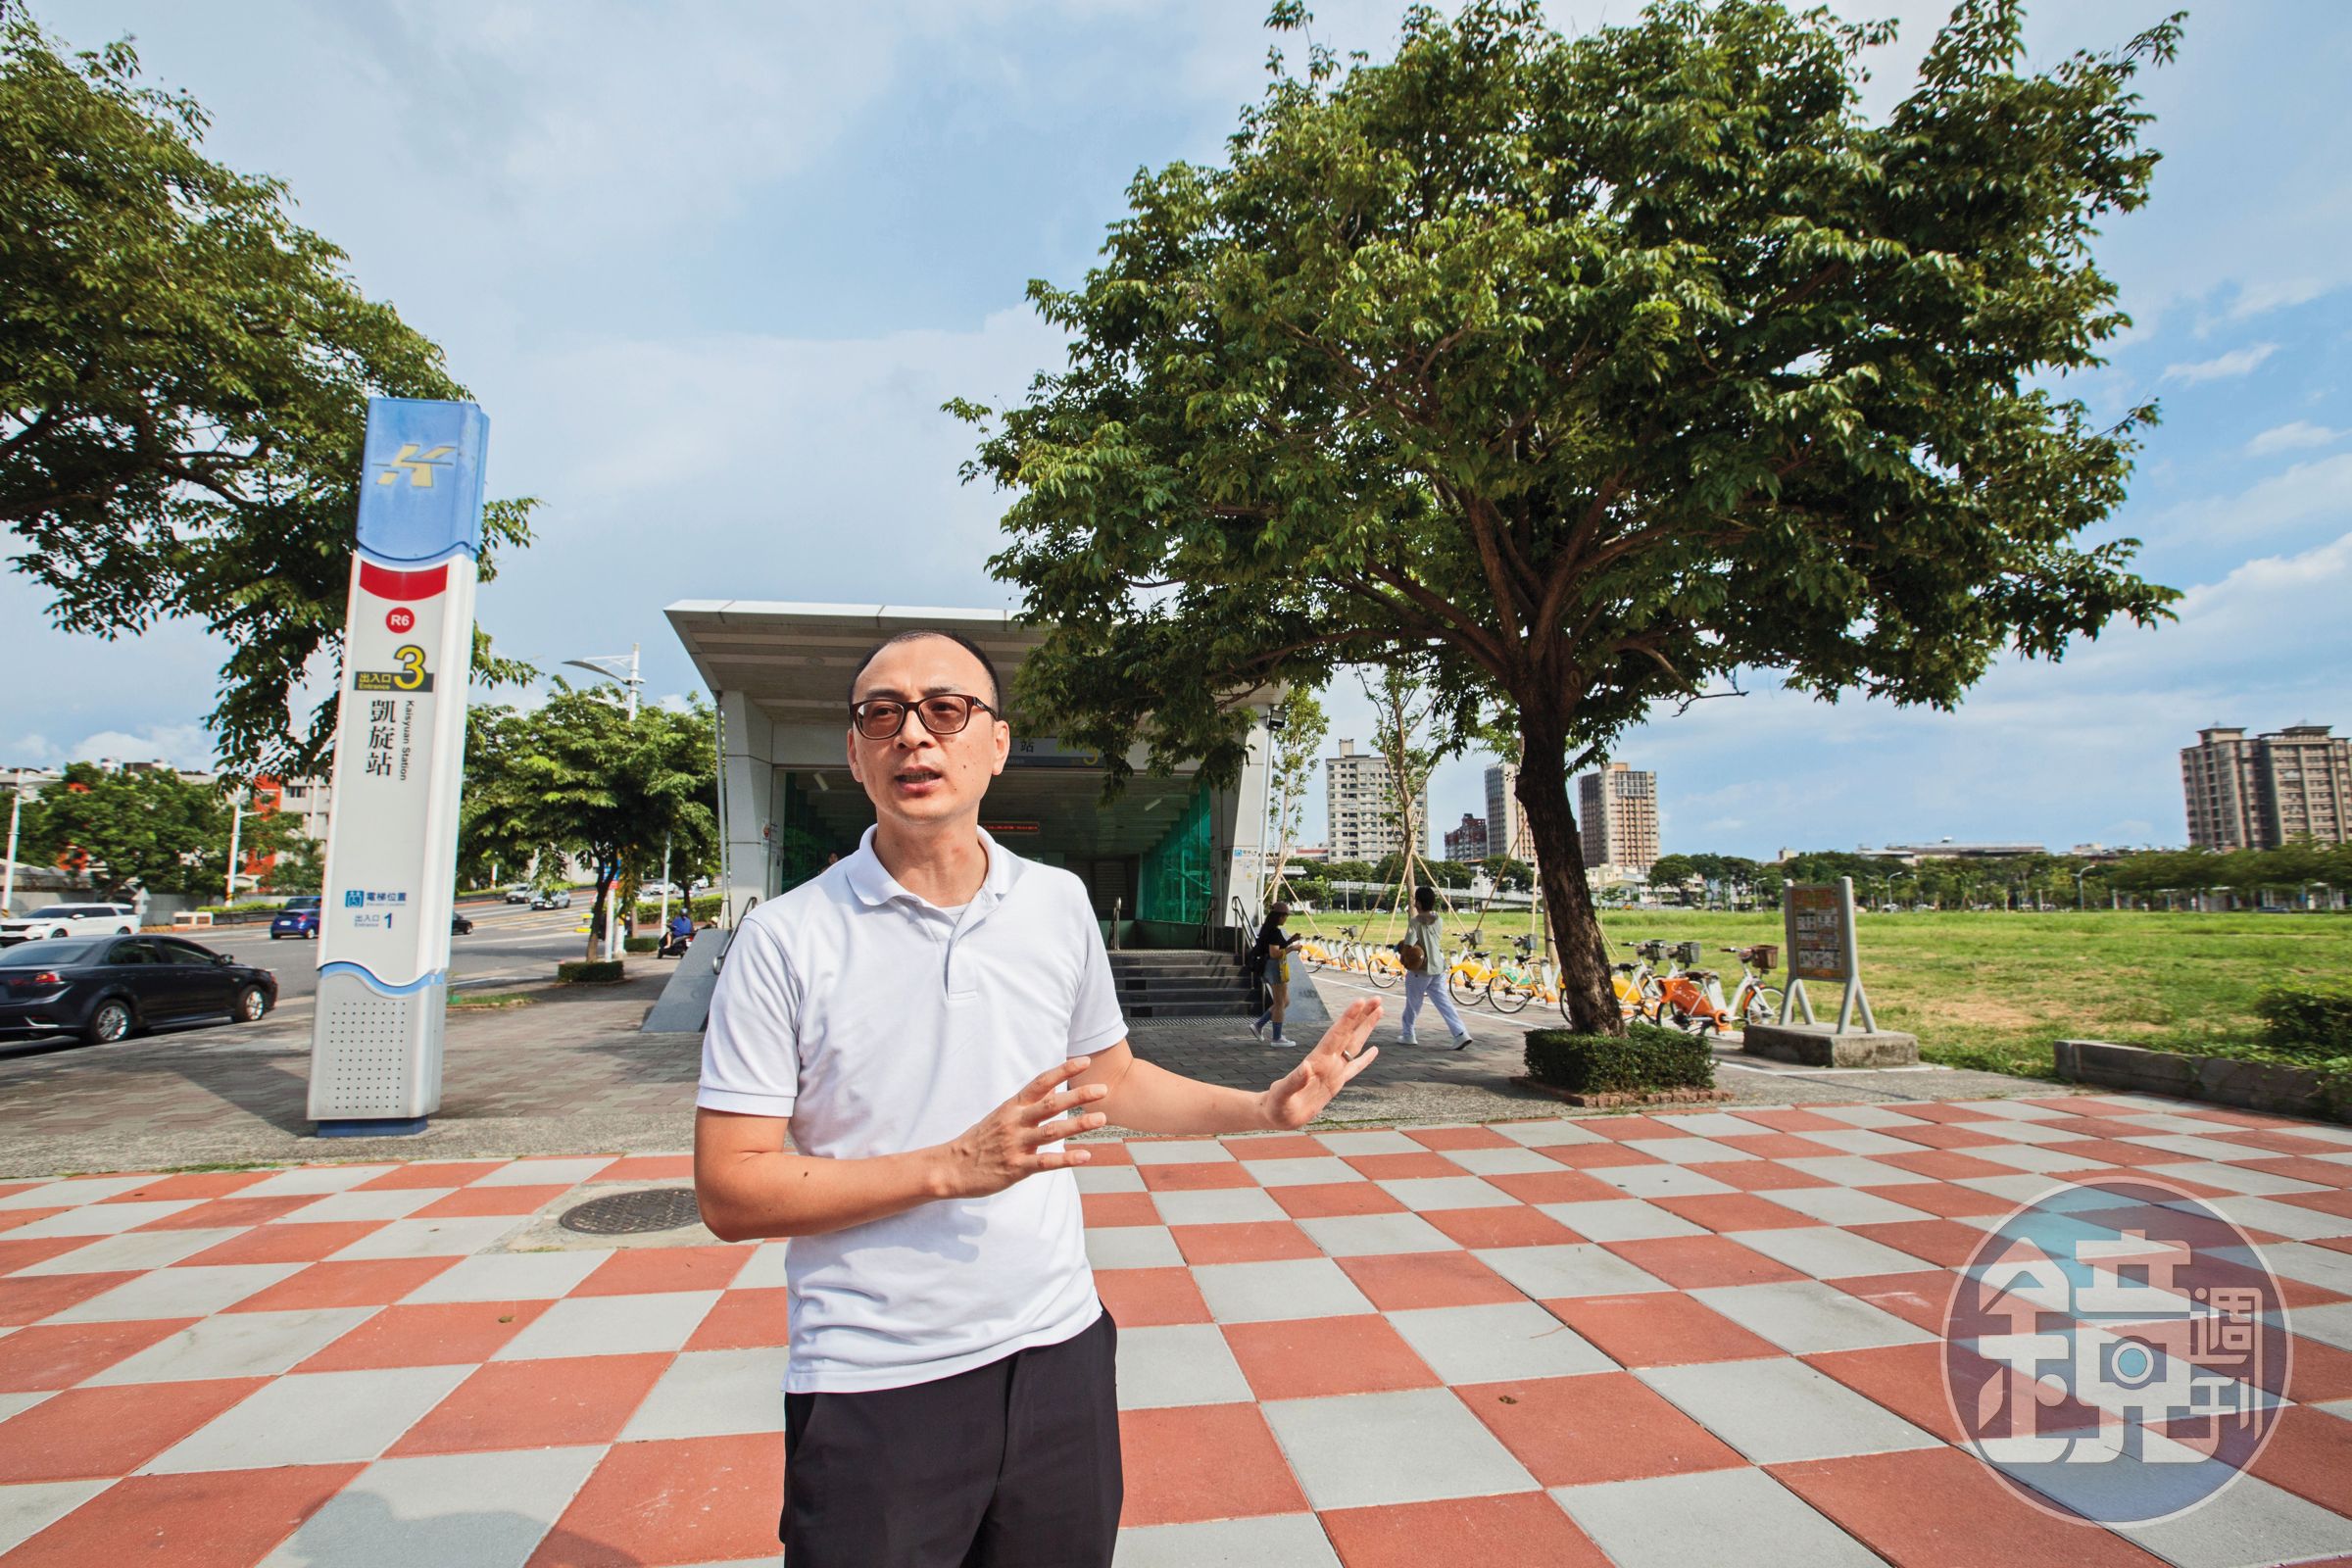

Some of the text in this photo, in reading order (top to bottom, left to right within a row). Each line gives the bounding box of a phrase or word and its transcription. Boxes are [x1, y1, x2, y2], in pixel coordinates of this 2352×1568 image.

[391, 613, 411, 626] R6
[359, 673, 392, 683] 出入口
[393, 644, 425, 690] 3
[366, 700, 396, 776] 凱旋站
[400, 700, 416, 781] Kaisyuan Station
[384, 912, 392, 929] 1
